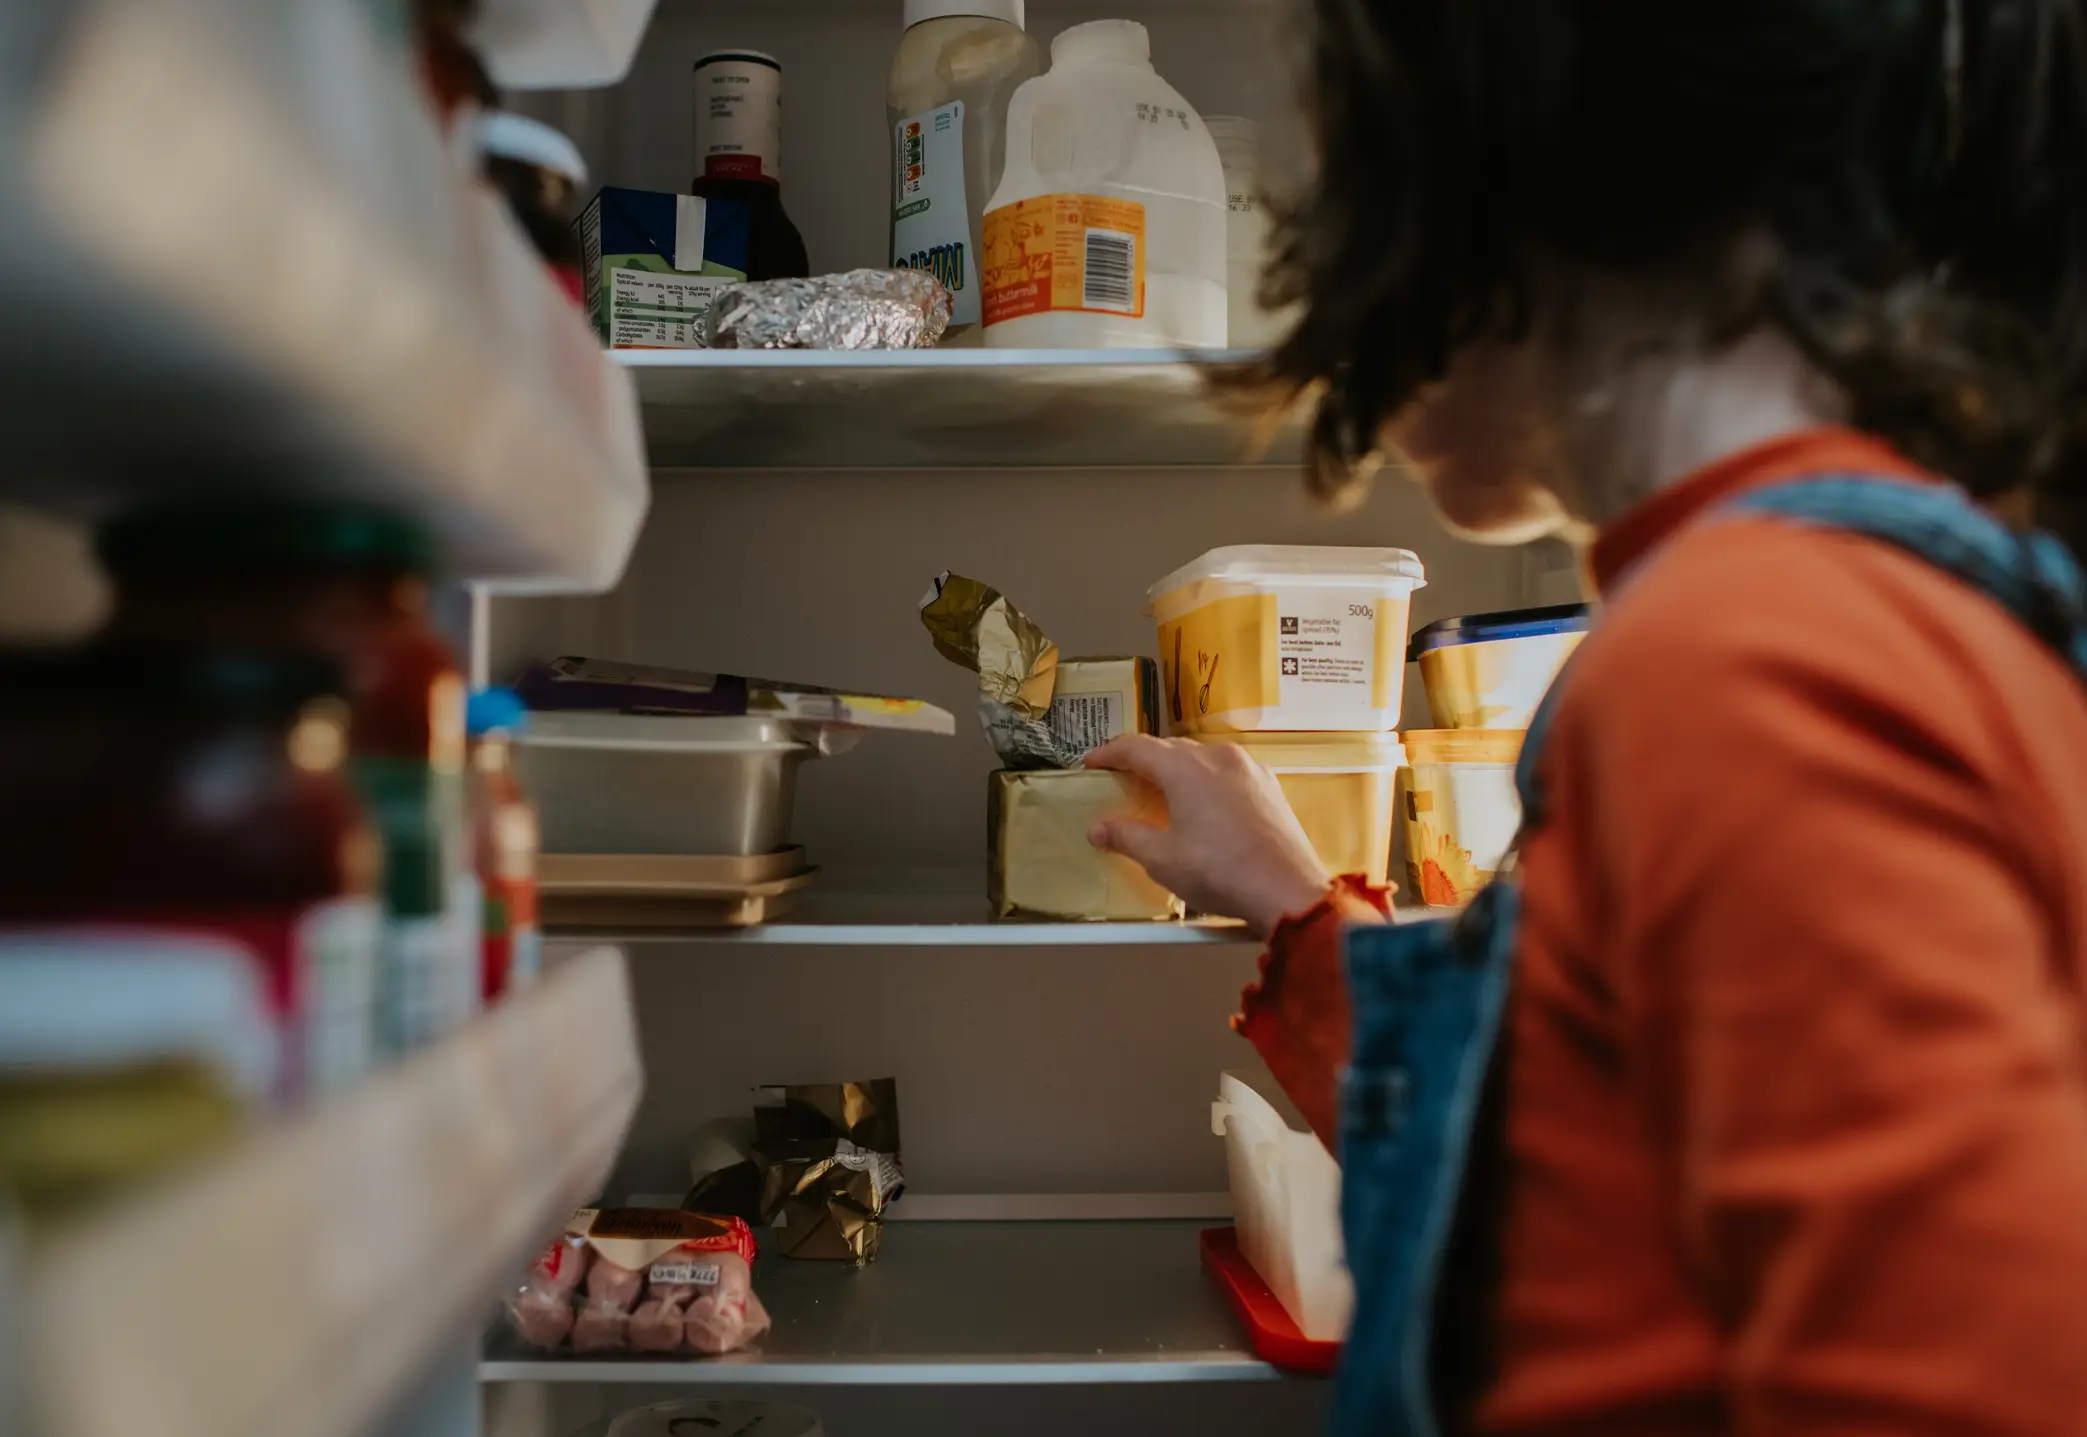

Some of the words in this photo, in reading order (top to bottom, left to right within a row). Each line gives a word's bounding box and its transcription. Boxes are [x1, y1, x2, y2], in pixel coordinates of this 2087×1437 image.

[1228, 194, 1243, 203] USE
[1348, 604, 1373, 619] 500g
[1302, 618, 1332, 627] Vegetable
